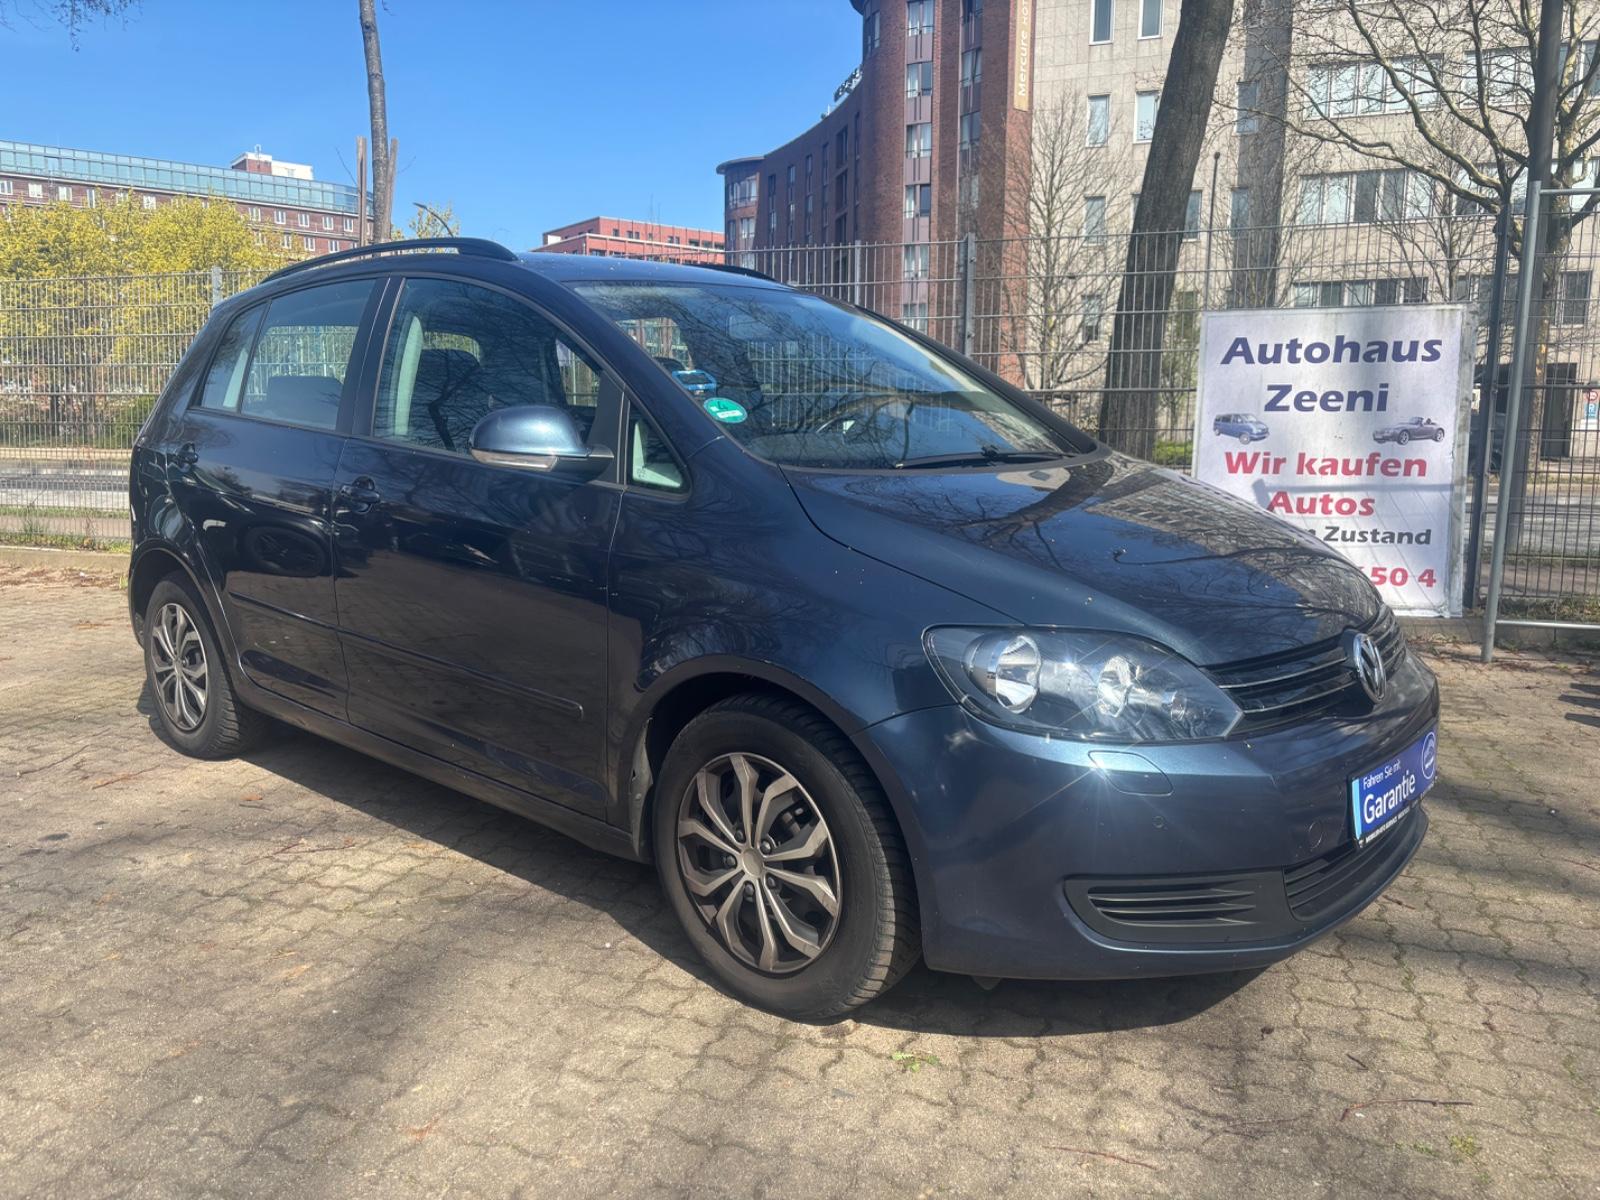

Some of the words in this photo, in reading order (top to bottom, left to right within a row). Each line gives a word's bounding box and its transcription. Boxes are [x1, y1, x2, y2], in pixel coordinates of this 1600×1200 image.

[1018, 30, 1028, 96] Mercure
[1220, 335, 1443, 365] Autohaus
[1264, 383, 1389, 412] Zeeni
[1225, 451, 1287, 475] Wir
[1296, 452, 1428, 477] kaufen
[1267, 491, 1375, 516] Autos
[1323, 526, 1432, 545] Zustand
[1418, 568, 1437, 588] 4
[1363, 774, 1384, 790] Fahren
[1384, 765, 1393, 779] Sie
[1393, 760, 1401, 775] mit
[1363, 770, 1416, 824] Garantie
